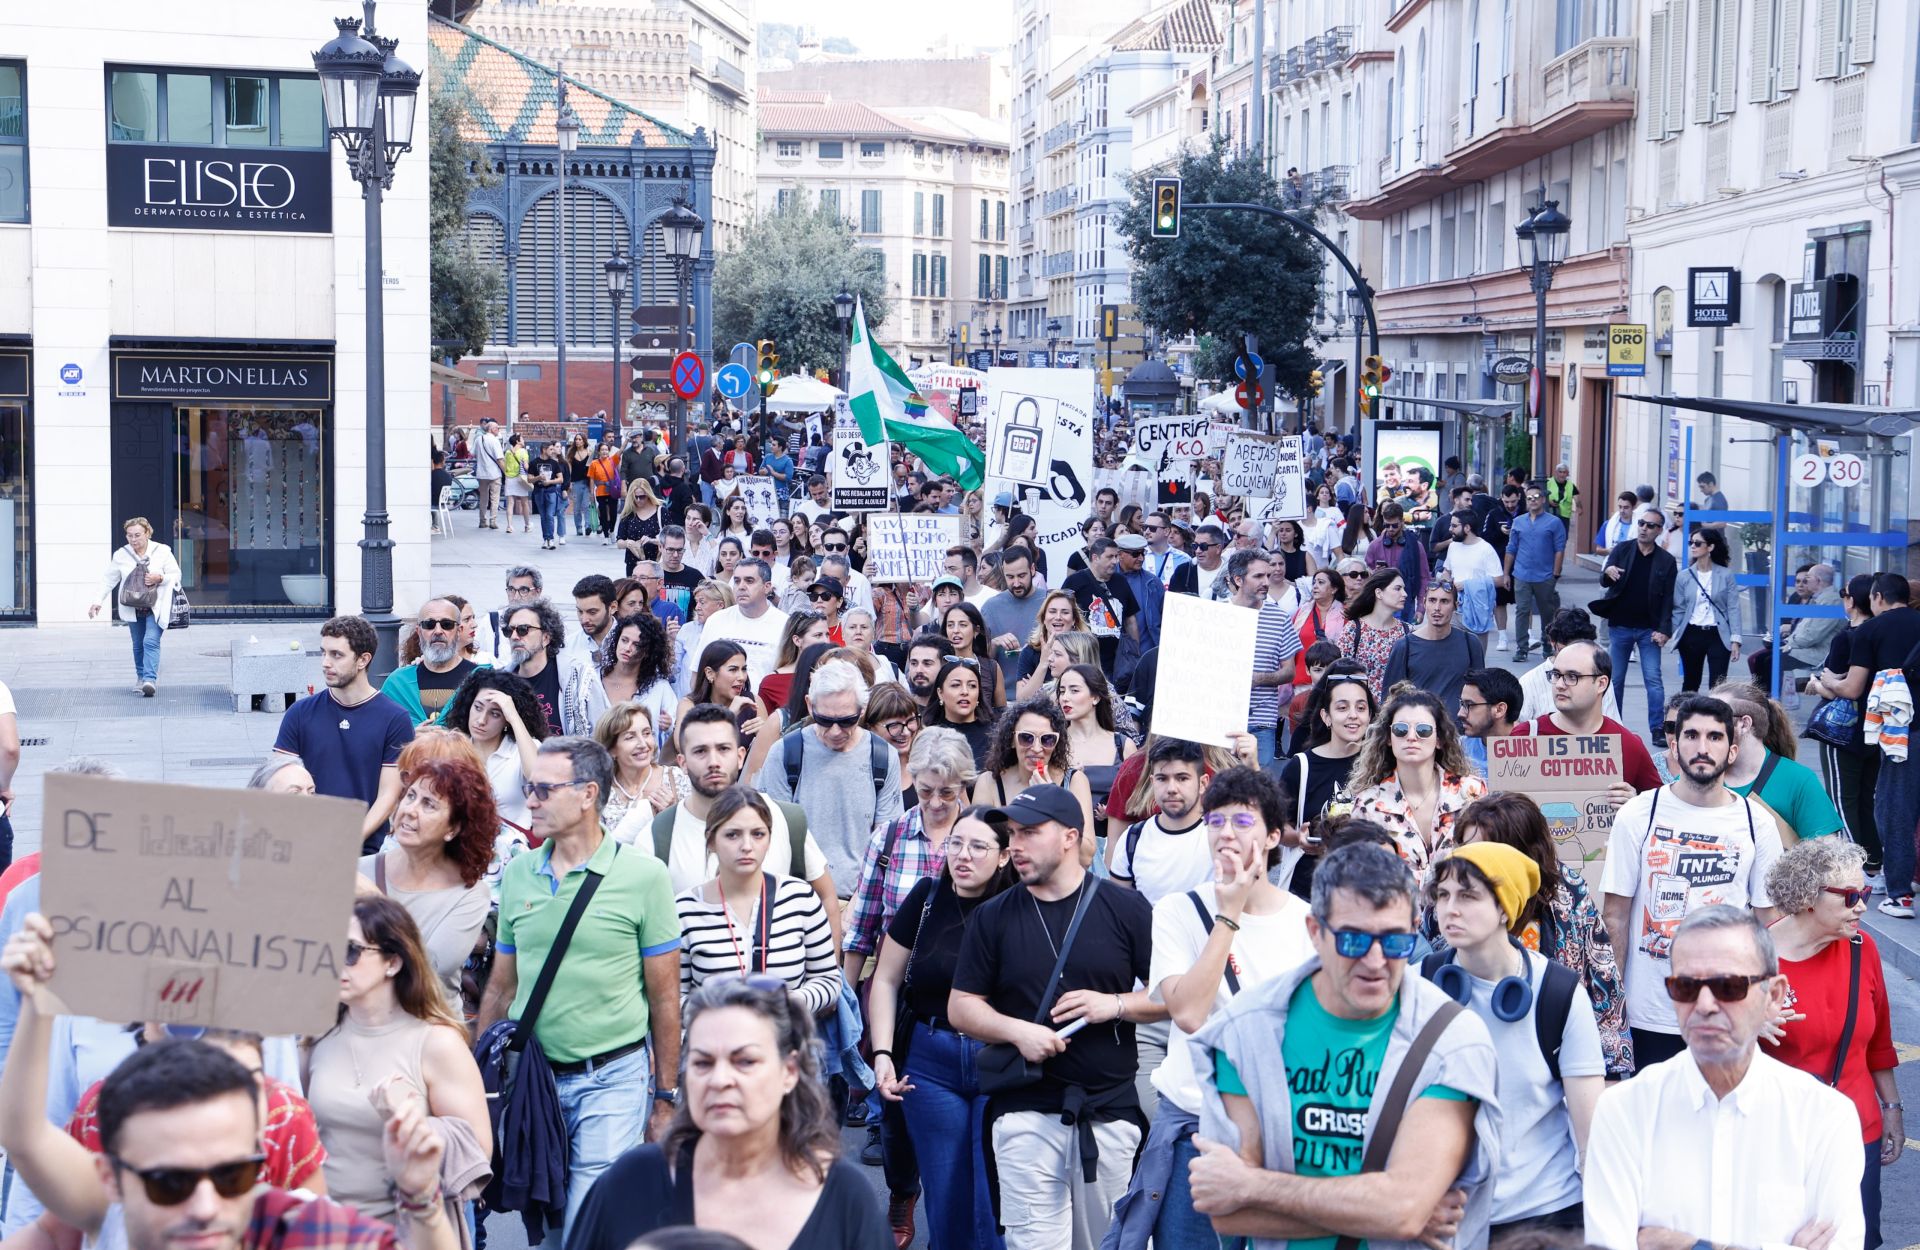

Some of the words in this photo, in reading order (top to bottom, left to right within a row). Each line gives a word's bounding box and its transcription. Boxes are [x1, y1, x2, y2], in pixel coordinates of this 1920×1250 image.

[144, 158, 295, 209] ELISEO
[134, 207, 230, 218] DERMATOLOGÍA
[249, 211, 306, 220] ESTÉTICA
[382, 277, 400, 285] TEROS
[1703, 280, 1720, 297] A
[1792, 291, 1821, 317] HOTEL
[1694, 309, 1728, 317] HOTEL
[1611, 333, 1643, 345] ORO
[140, 366, 308, 386] MARTONELLAS
[1058, 415, 1085, 437] STÁ
[836, 431, 847, 439] LOS
[1285, 440, 1297, 448] VEZ
[1234, 444, 1277, 461] ABEJAS
[1280, 451, 1297, 461] NDRÉ
[1242, 461, 1263, 473] SIN
[1802, 460, 1817, 480] 2
[1833, 460, 1862, 480] 30
[873, 519, 907, 529] VIVO
[917, 519, 941, 529] DEL
[1038, 521, 1083, 545] FICADA
[910, 549, 946, 560] TURIS
[844, 586, 857, 601] EY
[1493, 738, 1538, 758] GUIRI
[1548, 737, 1568, 756] IS
[1576, 736, 1610, 754] THE
[1540, 758, 1618, 777] COTORRA
[1587, 818, 1595, 829] &
[63, 808, 117, 853] DE
[138, 814, 293, 864] idealista
[1680, 858, 1718, 873] TNT
[1692, 873, 1730, 883] PLUNGER
[159, 877, 208, 912] AL
[1660, 891, 1685, 901] ACME
[49, 914, 339, 980] PSICOANALISTA
[1335, 1047, 1380, 1098] Ru
